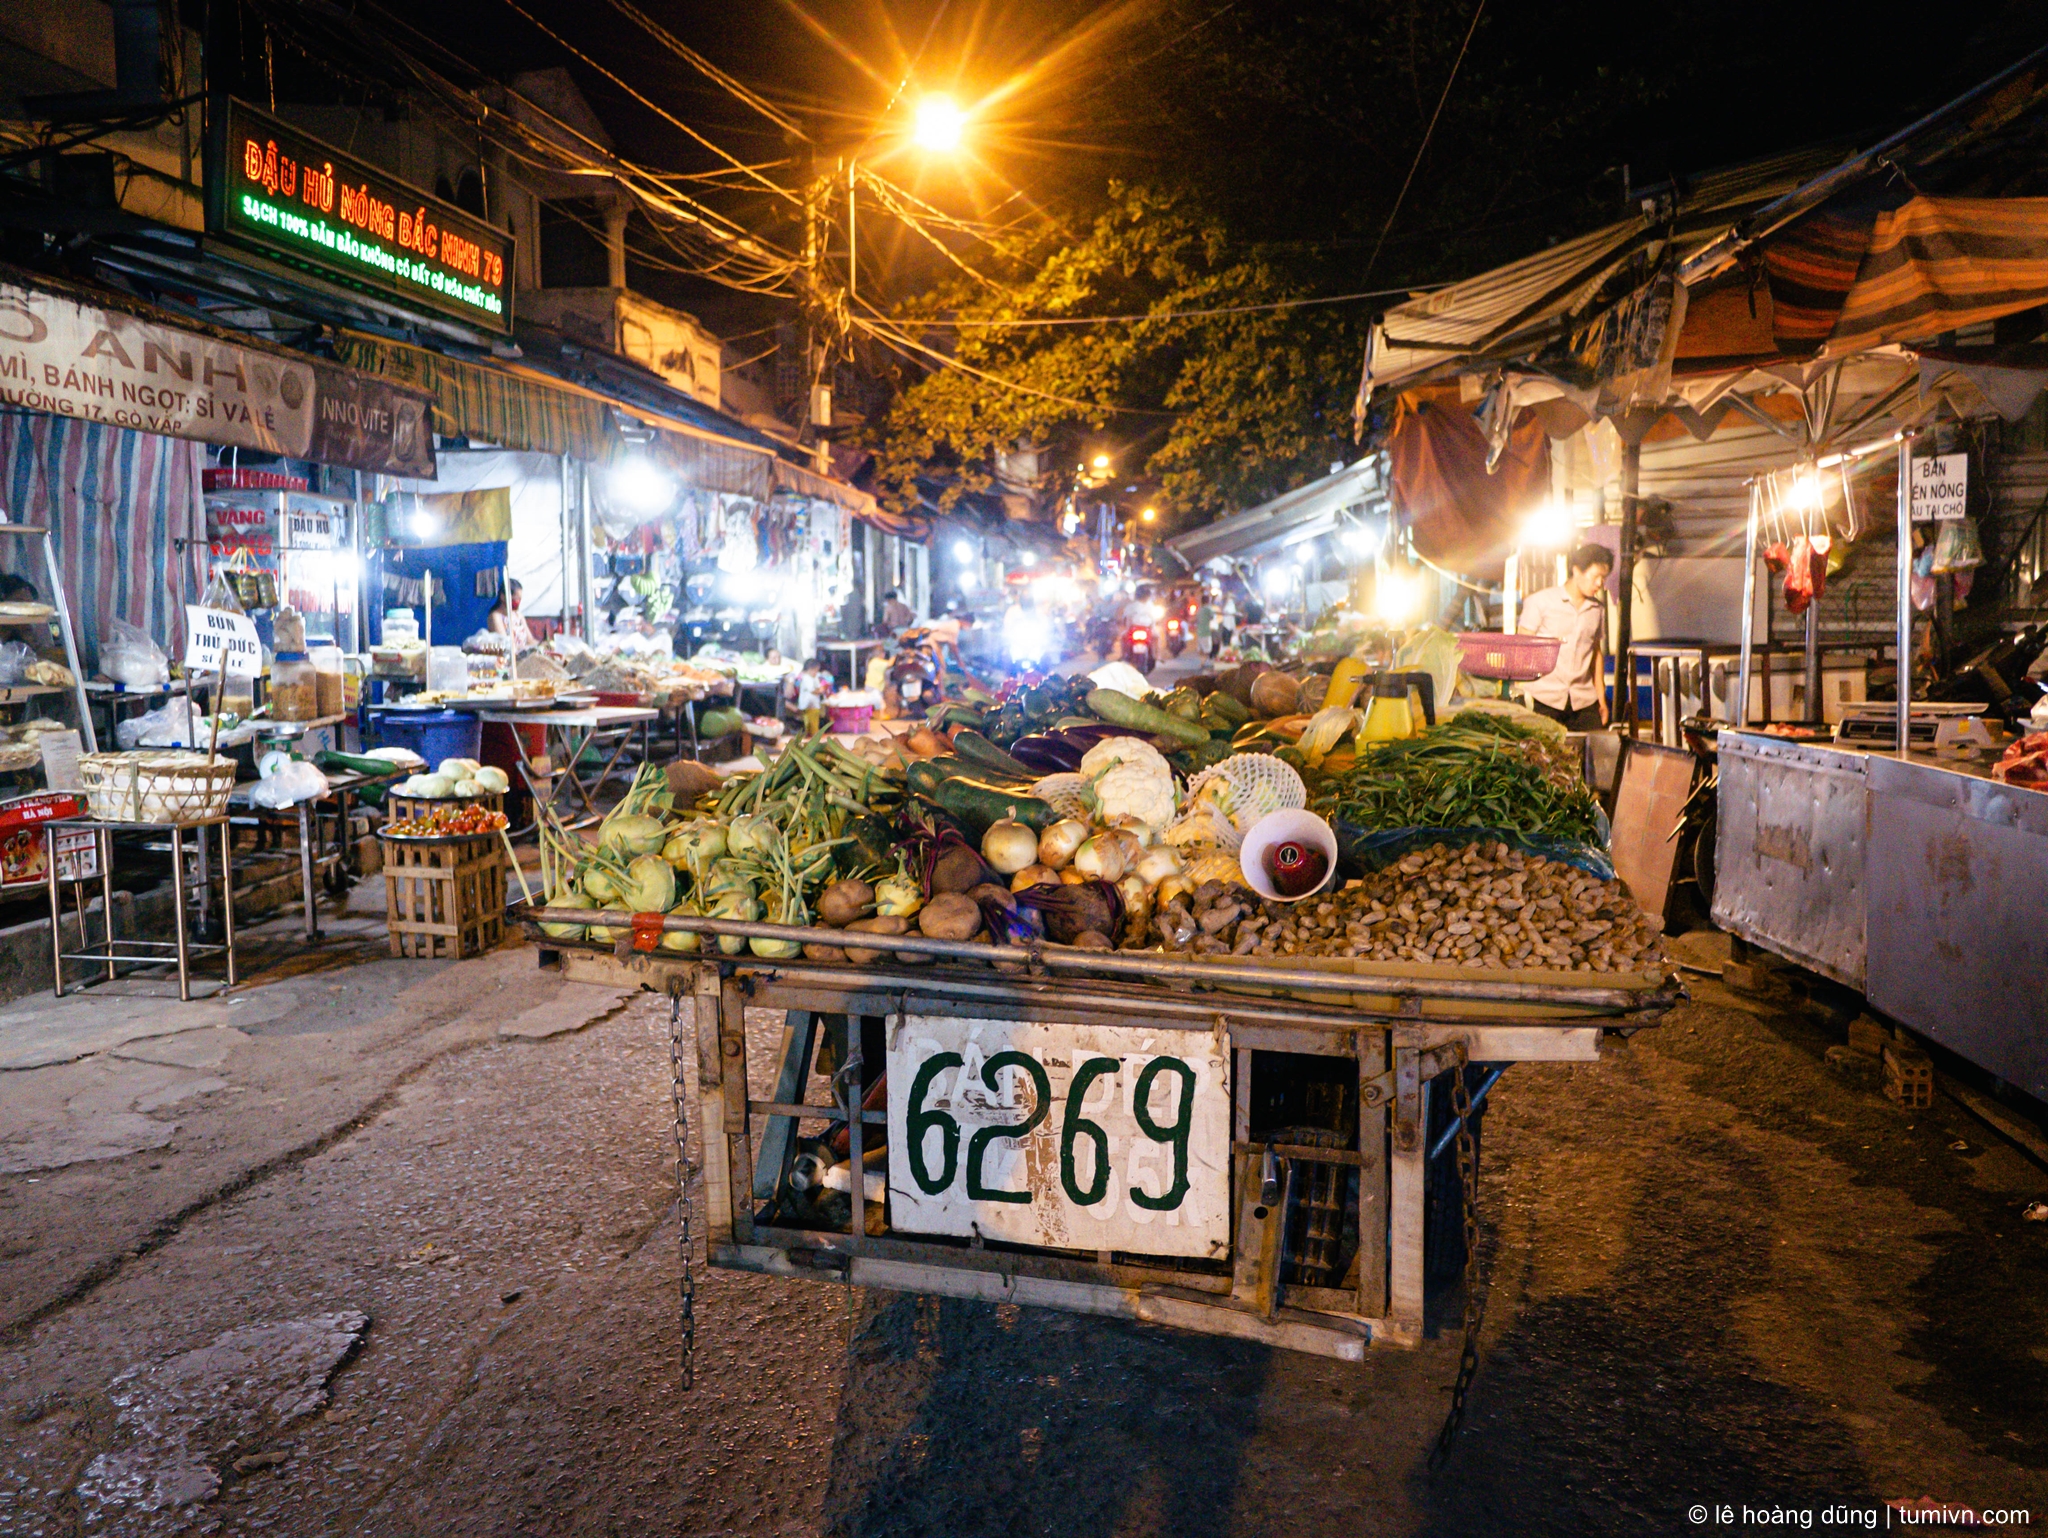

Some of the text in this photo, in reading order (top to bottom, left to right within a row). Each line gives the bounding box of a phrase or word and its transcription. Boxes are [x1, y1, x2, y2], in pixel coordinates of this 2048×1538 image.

[243, 195, 278, 225] SẠCH
[280, 211, 309, 238] 100%
[360, 243, 395, 273] KHÔNG
[396, 257, 410, 278] CÓ
[244, 139, 503, 286] ĐẬU HỦ NÓNG BẮC NINH 79
[81, 329, 247, 393] ANH
[43, 363, 115, 399] BÁNH
[222, 399, 252, 425] VÀ
[114, 409, 141, 427] GÒ
[1930, 480, 1964, 499] NÓNG
[907, 1050, 1197, 1211] 6269
